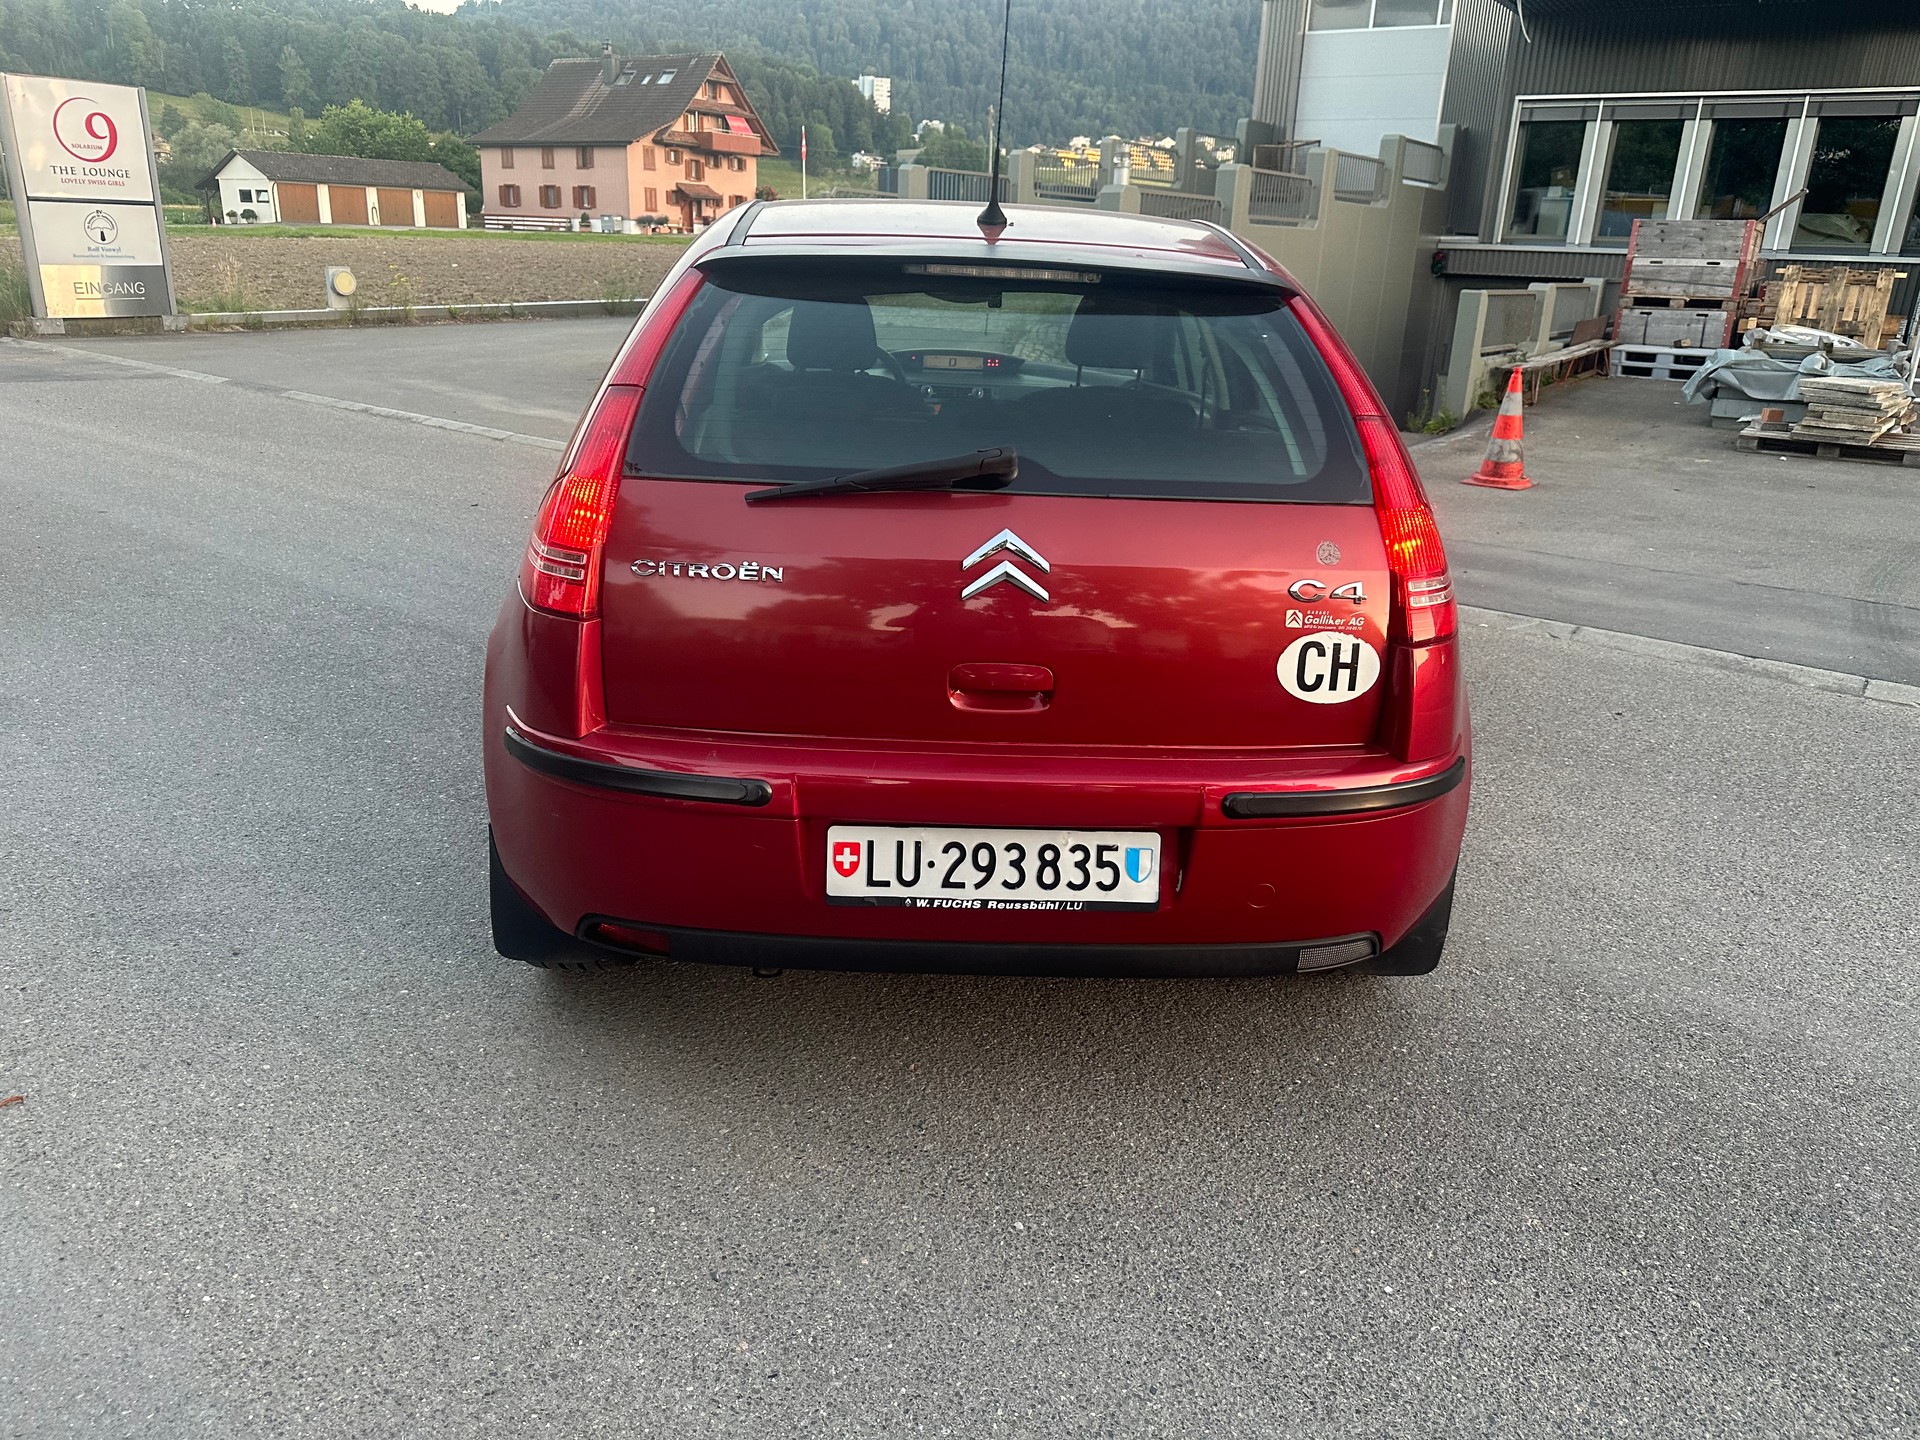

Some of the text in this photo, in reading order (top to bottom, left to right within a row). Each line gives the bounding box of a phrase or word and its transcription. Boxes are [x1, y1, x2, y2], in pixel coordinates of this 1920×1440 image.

[49, 165, 131, 178] THE LOUNGE
[73, 281, 146, 295] EINGANG
[630, 558, 783, 582] CITROËN
[1287, 578, 1368, 605] C4
[1304, 615, 1365, 626] Galliker AG
[1296, 640, 1360, 692] CH
[916, 898, 1083, 911] W. FUCHS Reussbühl/LU
